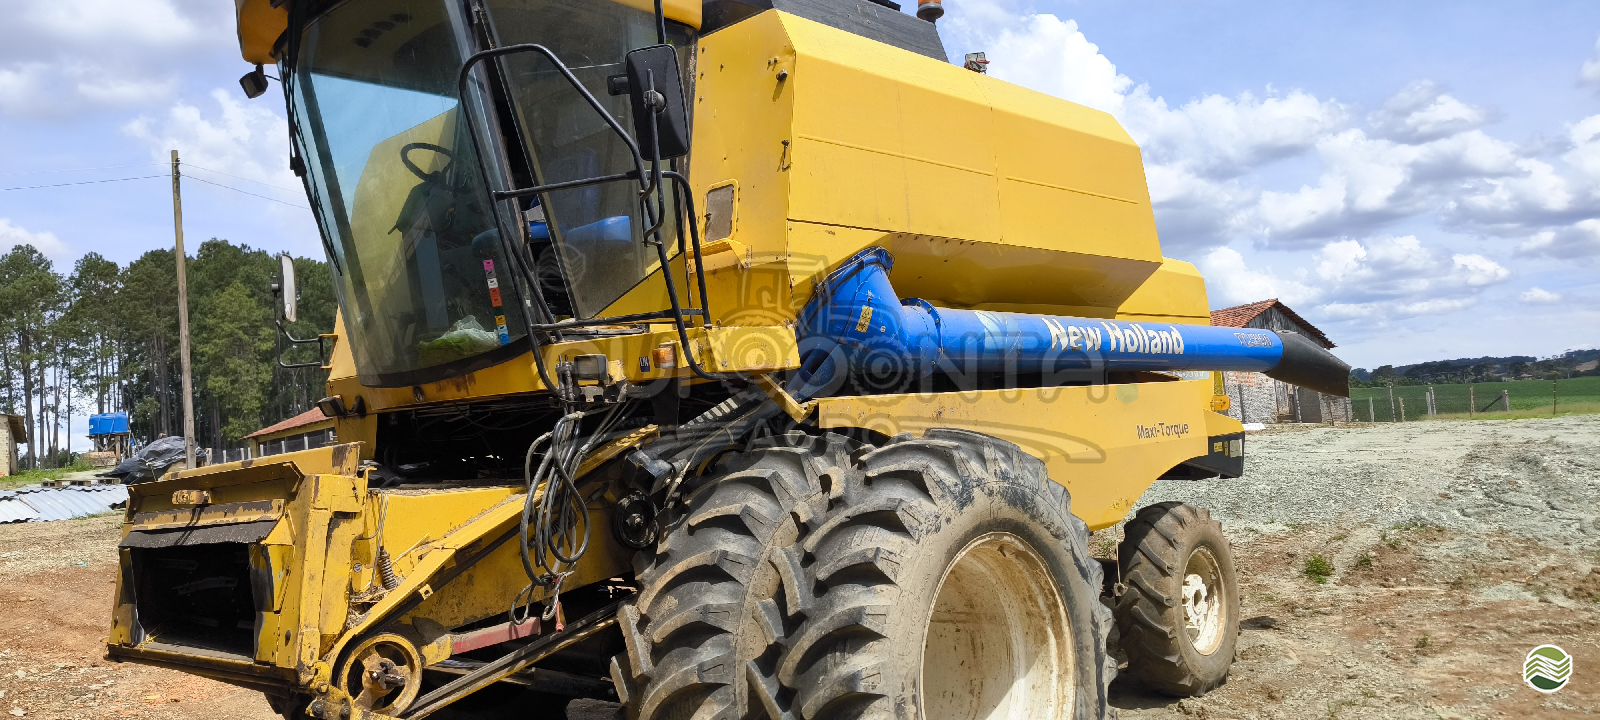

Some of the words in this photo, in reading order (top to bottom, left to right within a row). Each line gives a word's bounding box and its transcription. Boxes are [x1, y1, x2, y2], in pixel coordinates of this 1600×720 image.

[1042, 317, 1101, 351] New
[1101, 321, 1185, 354] Holland
[1136, 422, 1189, 439] Maxi-Torque
